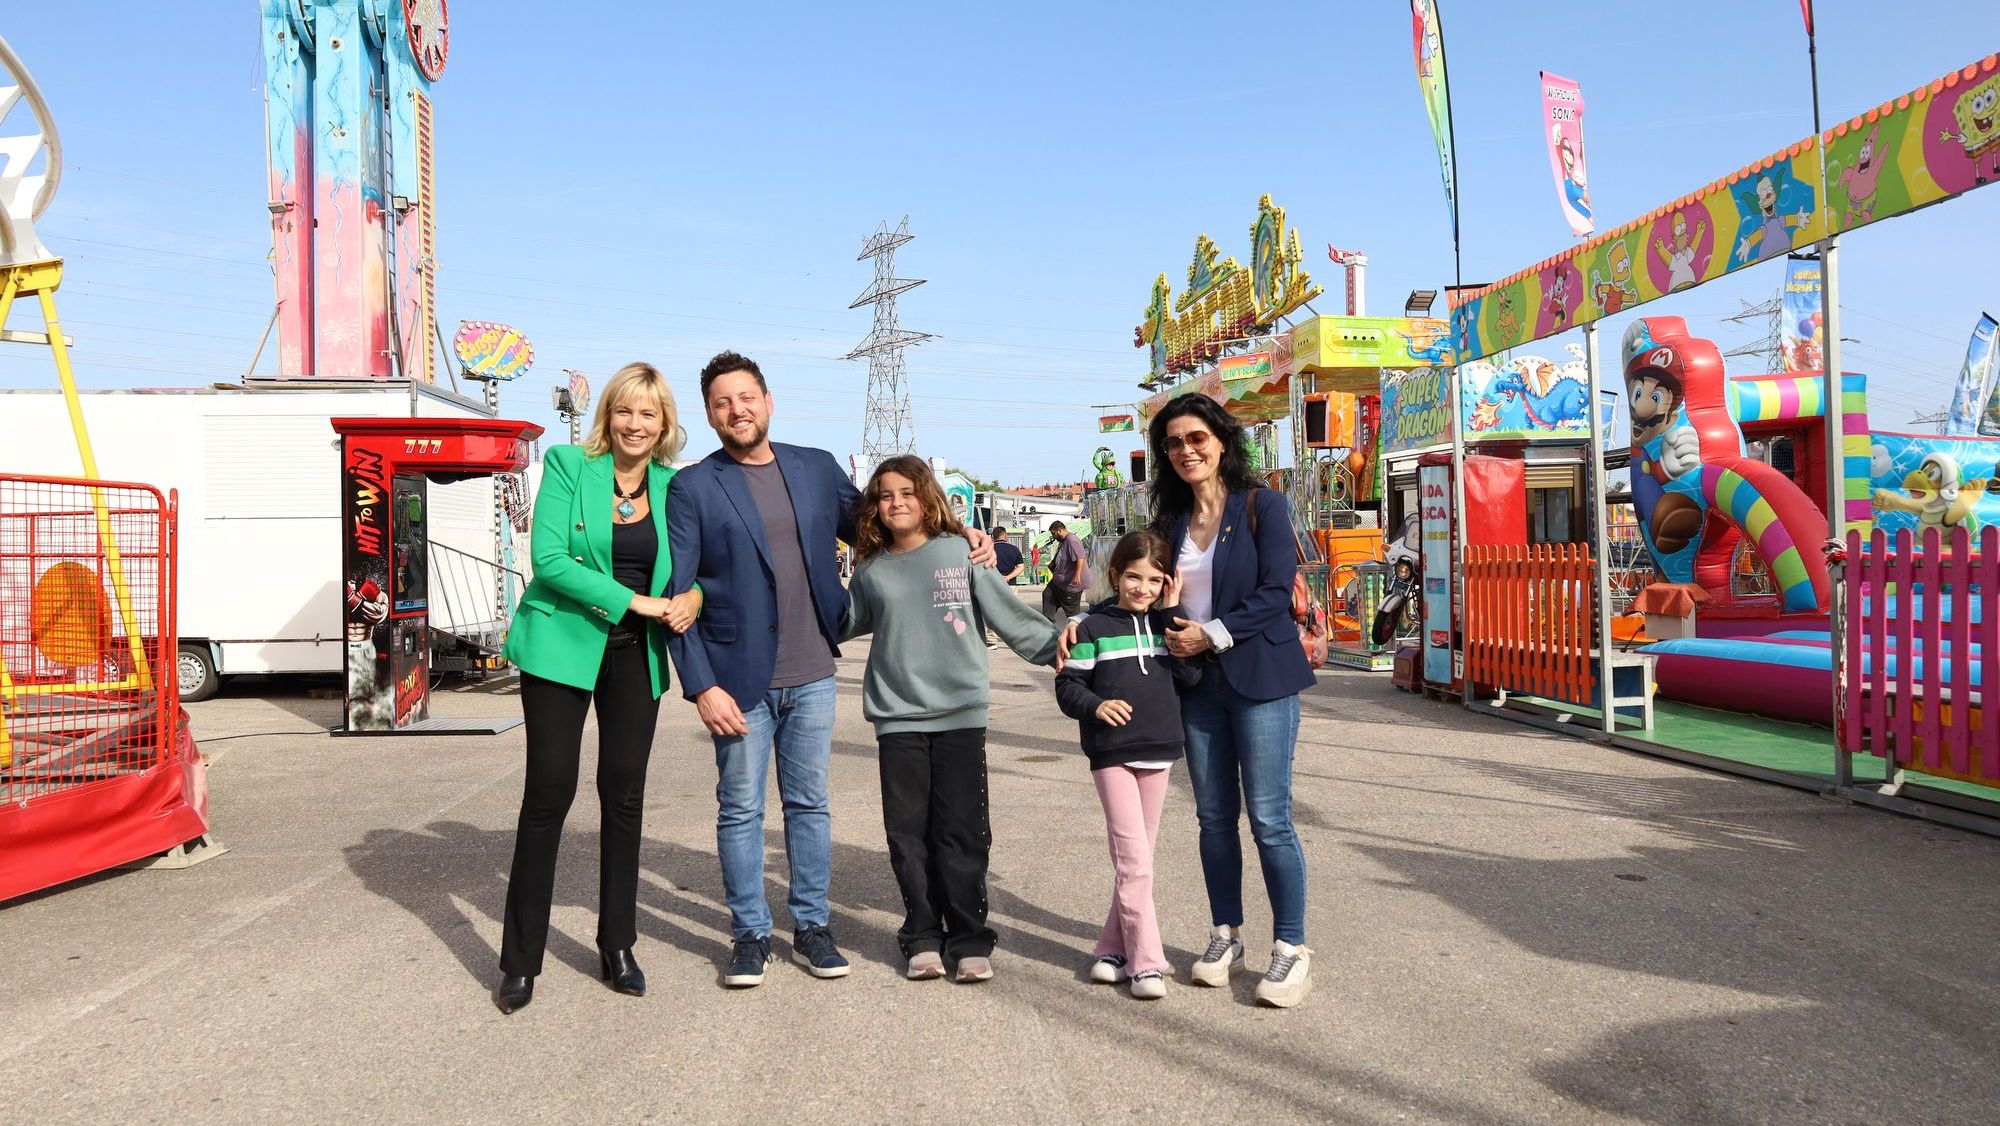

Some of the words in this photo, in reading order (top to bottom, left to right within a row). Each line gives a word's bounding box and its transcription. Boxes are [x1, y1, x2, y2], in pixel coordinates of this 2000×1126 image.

[1547, 87, 1576, 102] WIPEOU
[1400, 373, 1440, 408] SUPER
[404, 439, 443, 454] 777
[350, 515, 383, 556] HIT
[934, 567, 966, 579] ALWAY
[938, 577, 968, 589] THINK
